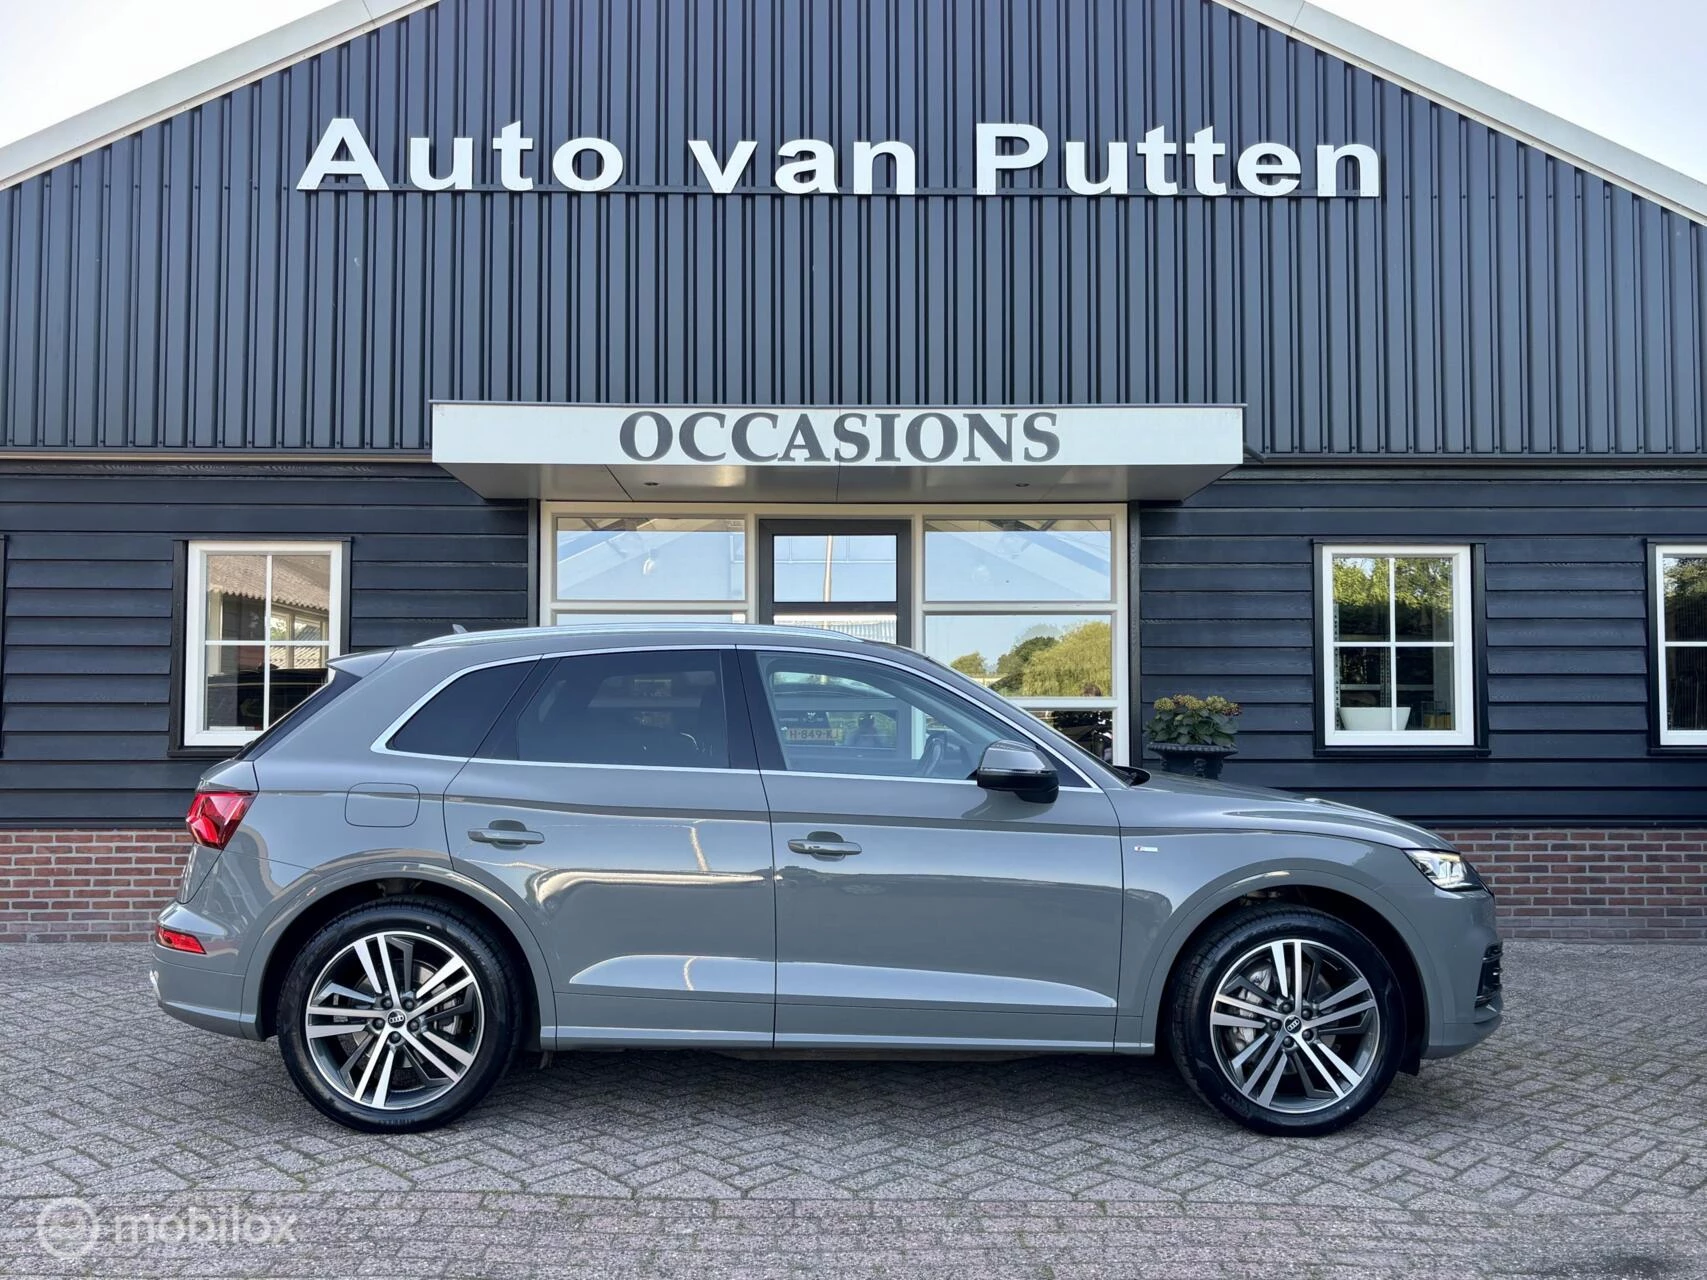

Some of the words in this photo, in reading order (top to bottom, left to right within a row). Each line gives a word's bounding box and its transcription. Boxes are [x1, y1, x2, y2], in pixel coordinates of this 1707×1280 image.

[297, 118, 624, 191] Auto
[687, 139, 916, 195] van
[976, 123, 1379, 197] Putten
[619, 411, 1061, 462] OCCASIONS
